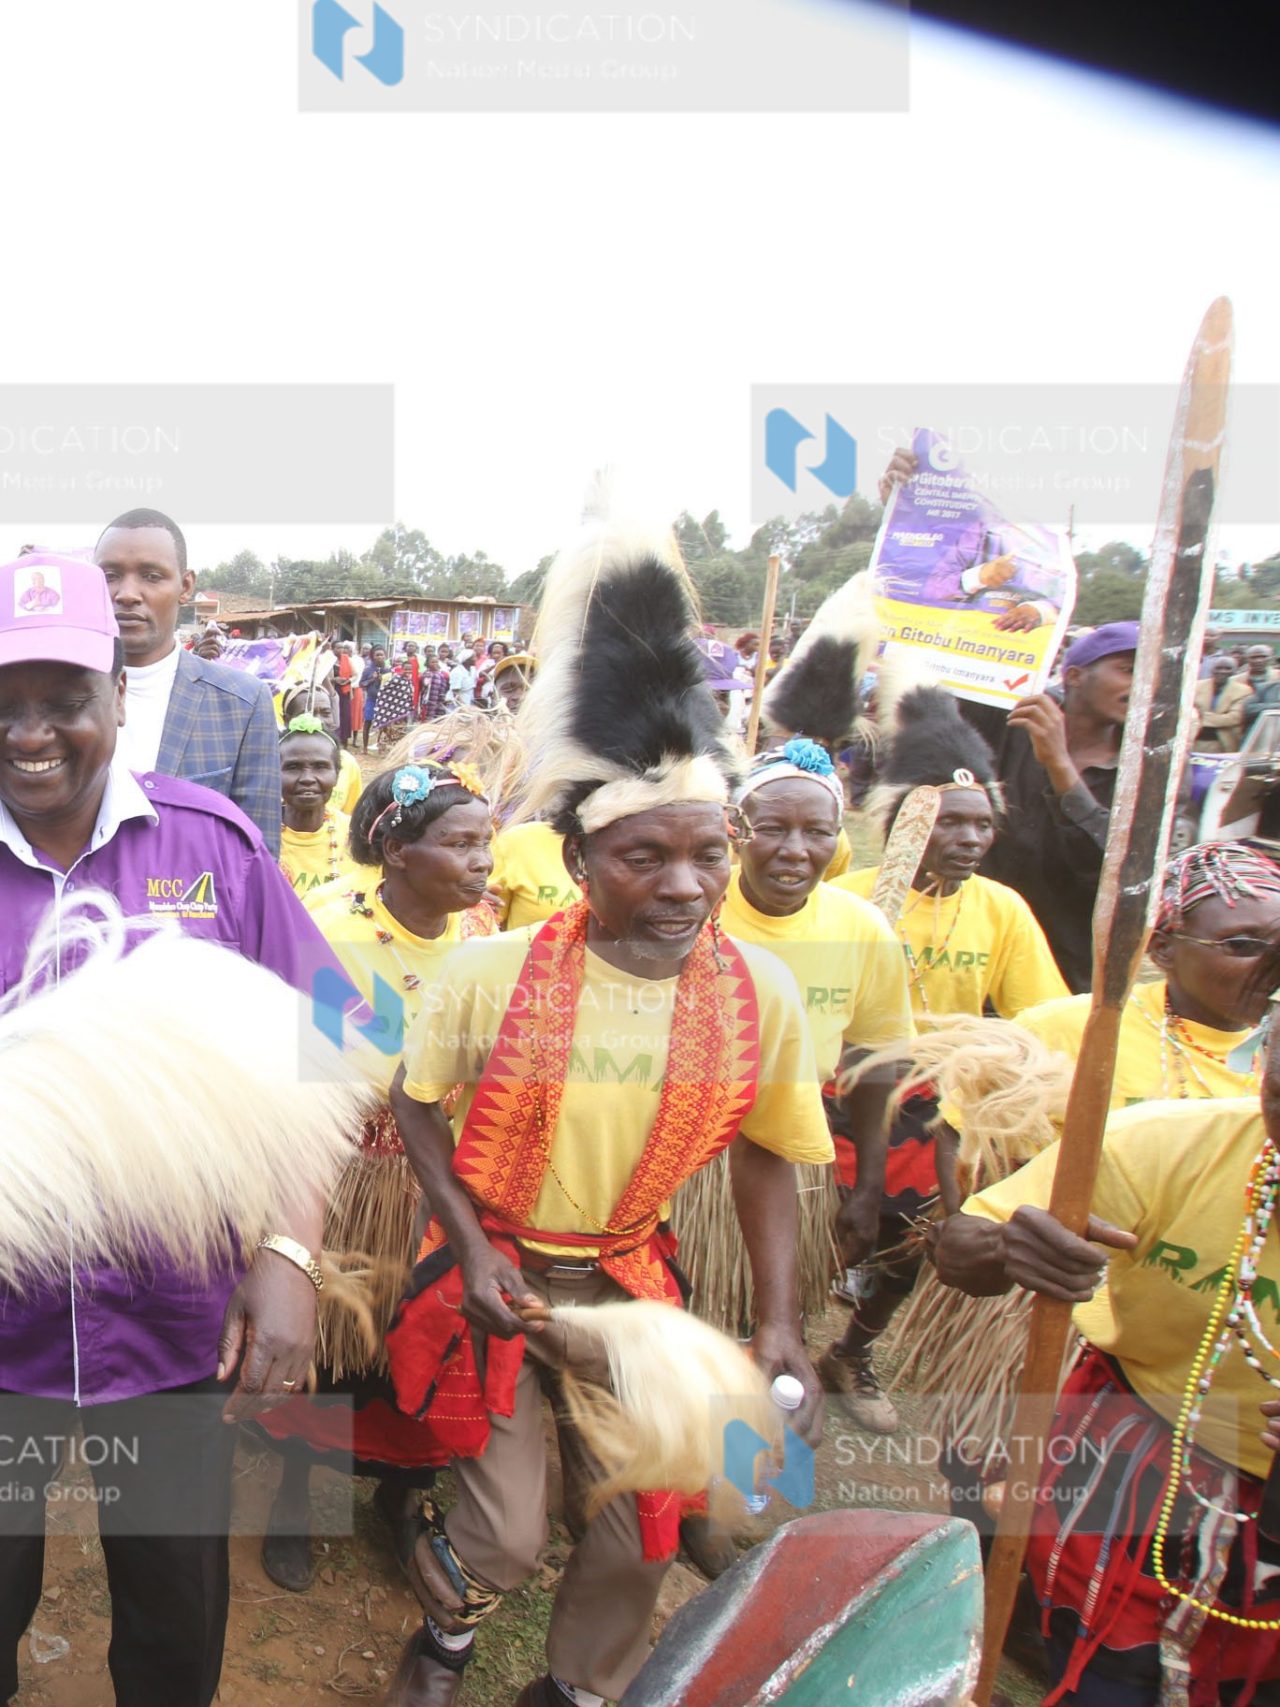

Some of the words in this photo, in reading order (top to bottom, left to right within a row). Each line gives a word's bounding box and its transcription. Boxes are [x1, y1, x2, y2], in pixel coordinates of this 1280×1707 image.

[900, 627, 951, 648] Gitobu
[955, 637, 1036, 664] Imanyara
[146, 878, 183, 898] MCC
